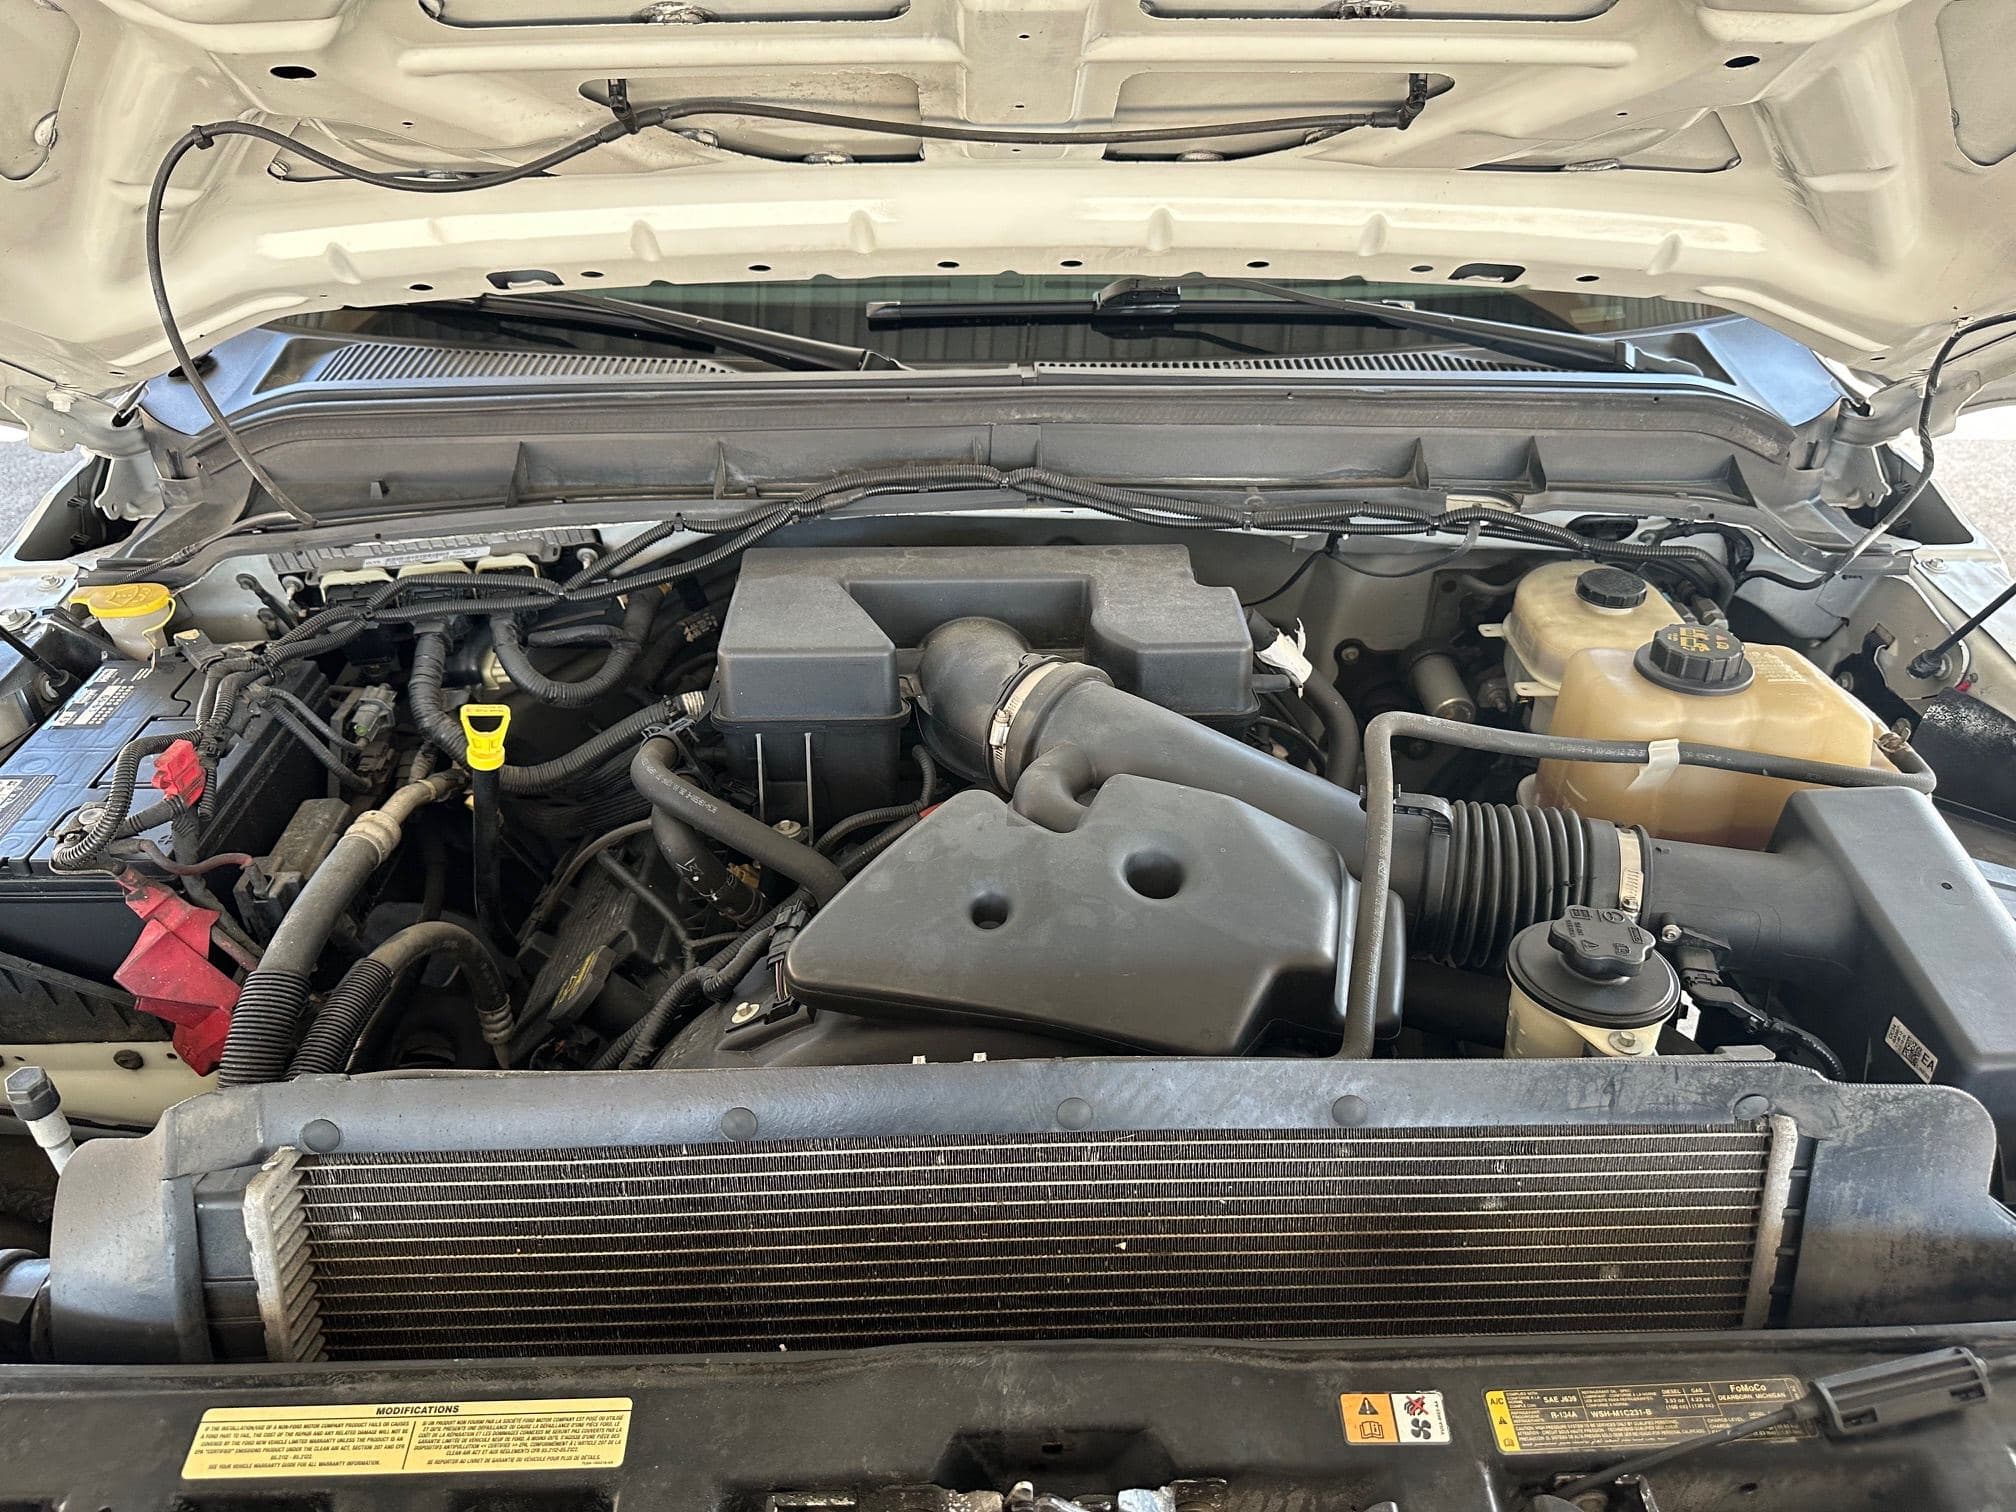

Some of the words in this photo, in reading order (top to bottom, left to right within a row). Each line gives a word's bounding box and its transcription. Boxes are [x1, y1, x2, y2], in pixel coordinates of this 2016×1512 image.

[1921, 1053, 1934, 1072] EA
[1729, 1384, 1766, 1392] FoMoCo
[1543, 1396, 1559, 1404] SAE
[376, 1406, 460, 1415] MODIFICATIONS
[1550, 1411, 1578, 1419] R-134A
